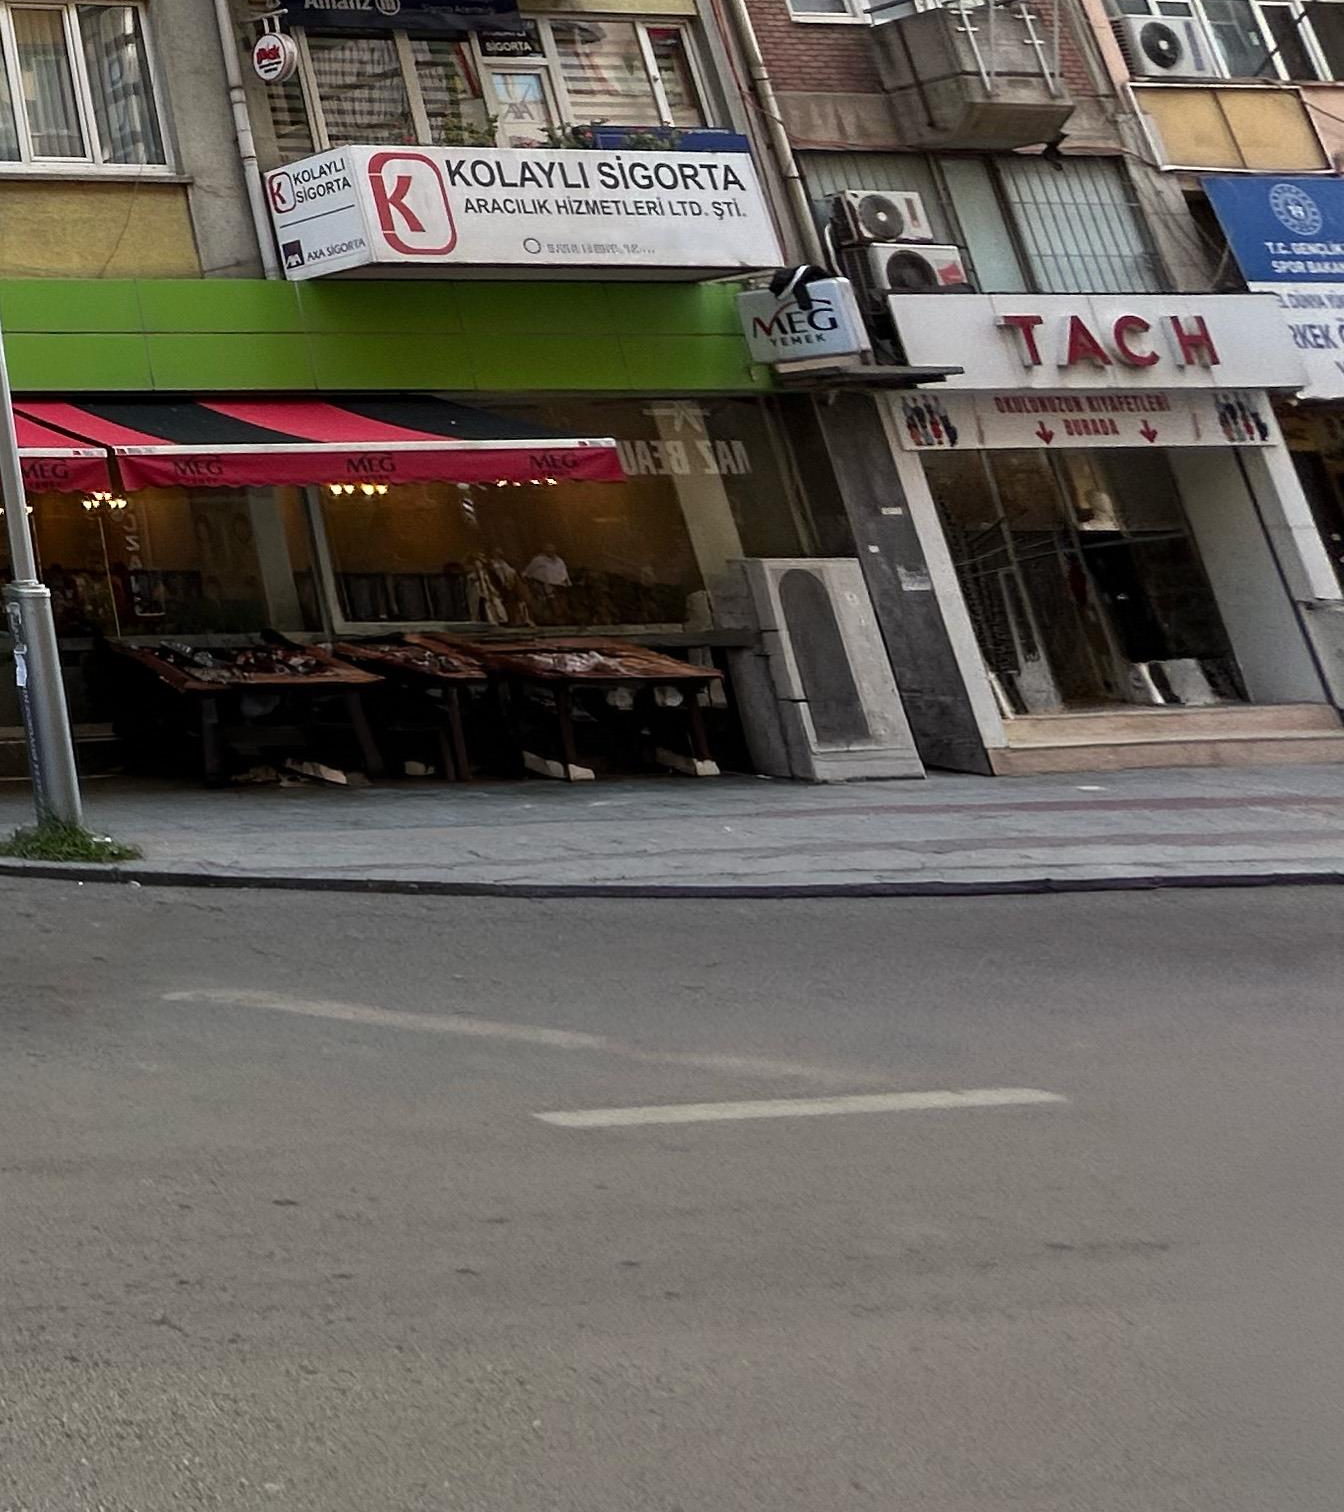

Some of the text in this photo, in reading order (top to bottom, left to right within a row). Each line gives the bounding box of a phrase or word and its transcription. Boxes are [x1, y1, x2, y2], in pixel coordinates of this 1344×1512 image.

[292, 157, 347, 187] KOLAYLI
[444, 155, 746, 192] KOLAYLI SİGORTA
[296, 176, 352, 204] SİGORTA
[464, 195, 749, 222] ARACILIK HİZMETLERİ LTD. ŞTİ.
[753, 299, 839, 338] MEG
[769, 332, 827, 347] YEMEK
[995, 314, 1221, 369] TACH
